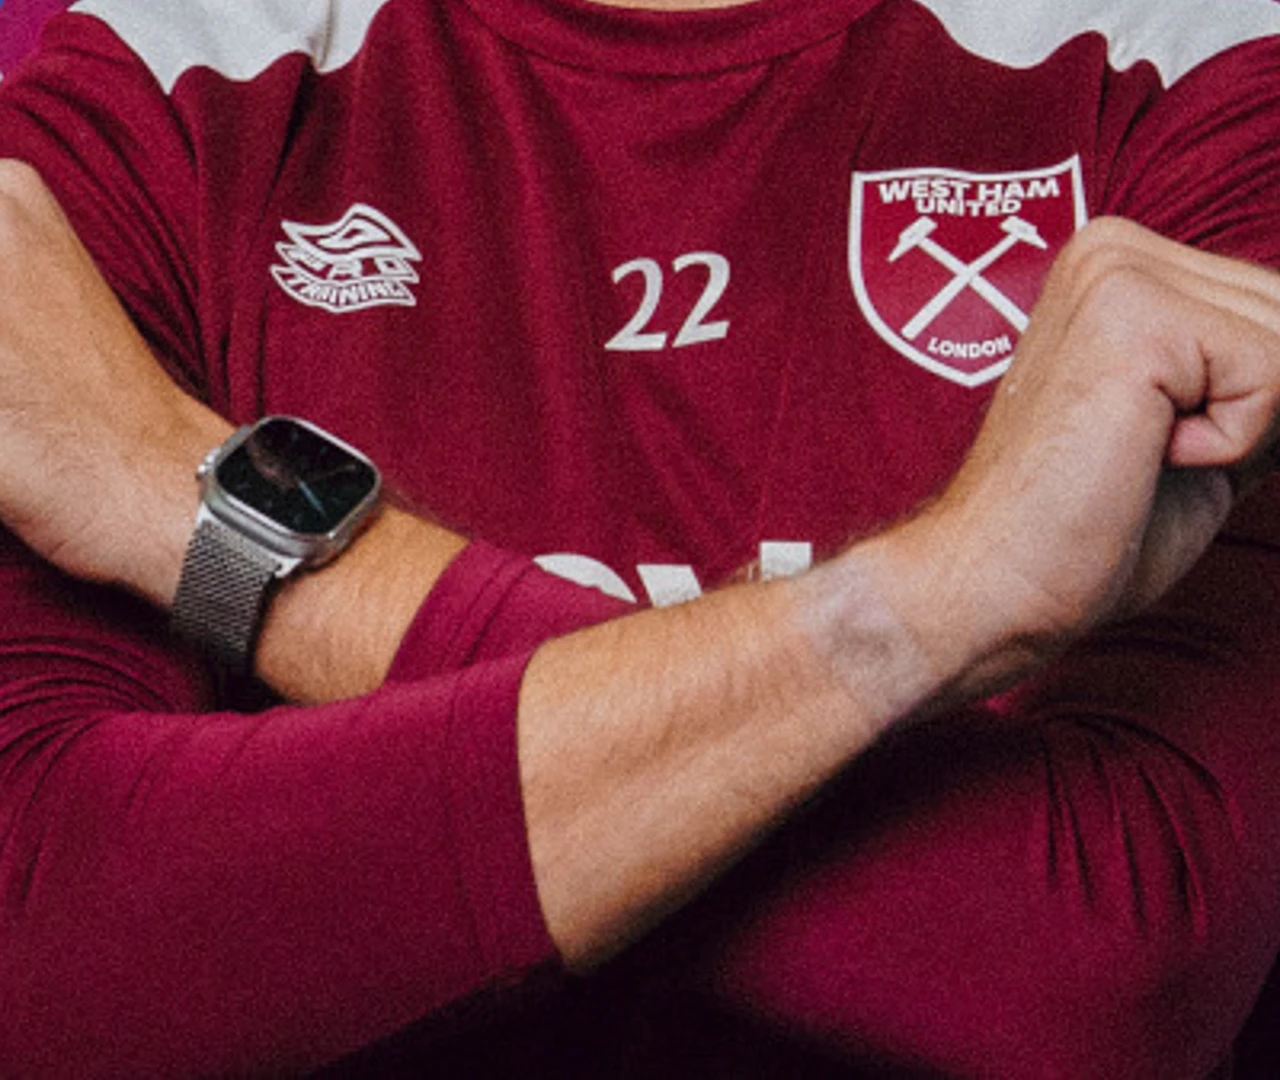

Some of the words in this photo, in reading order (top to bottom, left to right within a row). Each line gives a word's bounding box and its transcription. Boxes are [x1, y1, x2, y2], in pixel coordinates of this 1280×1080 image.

[878, 179, 969, 204] WEST
[978, 176, 1062, 203] HAM
[916, 198, 1022, 217] UNITED
[604, 251, 732, 351] 22
[927, 334, 1012, 359] LONDON
